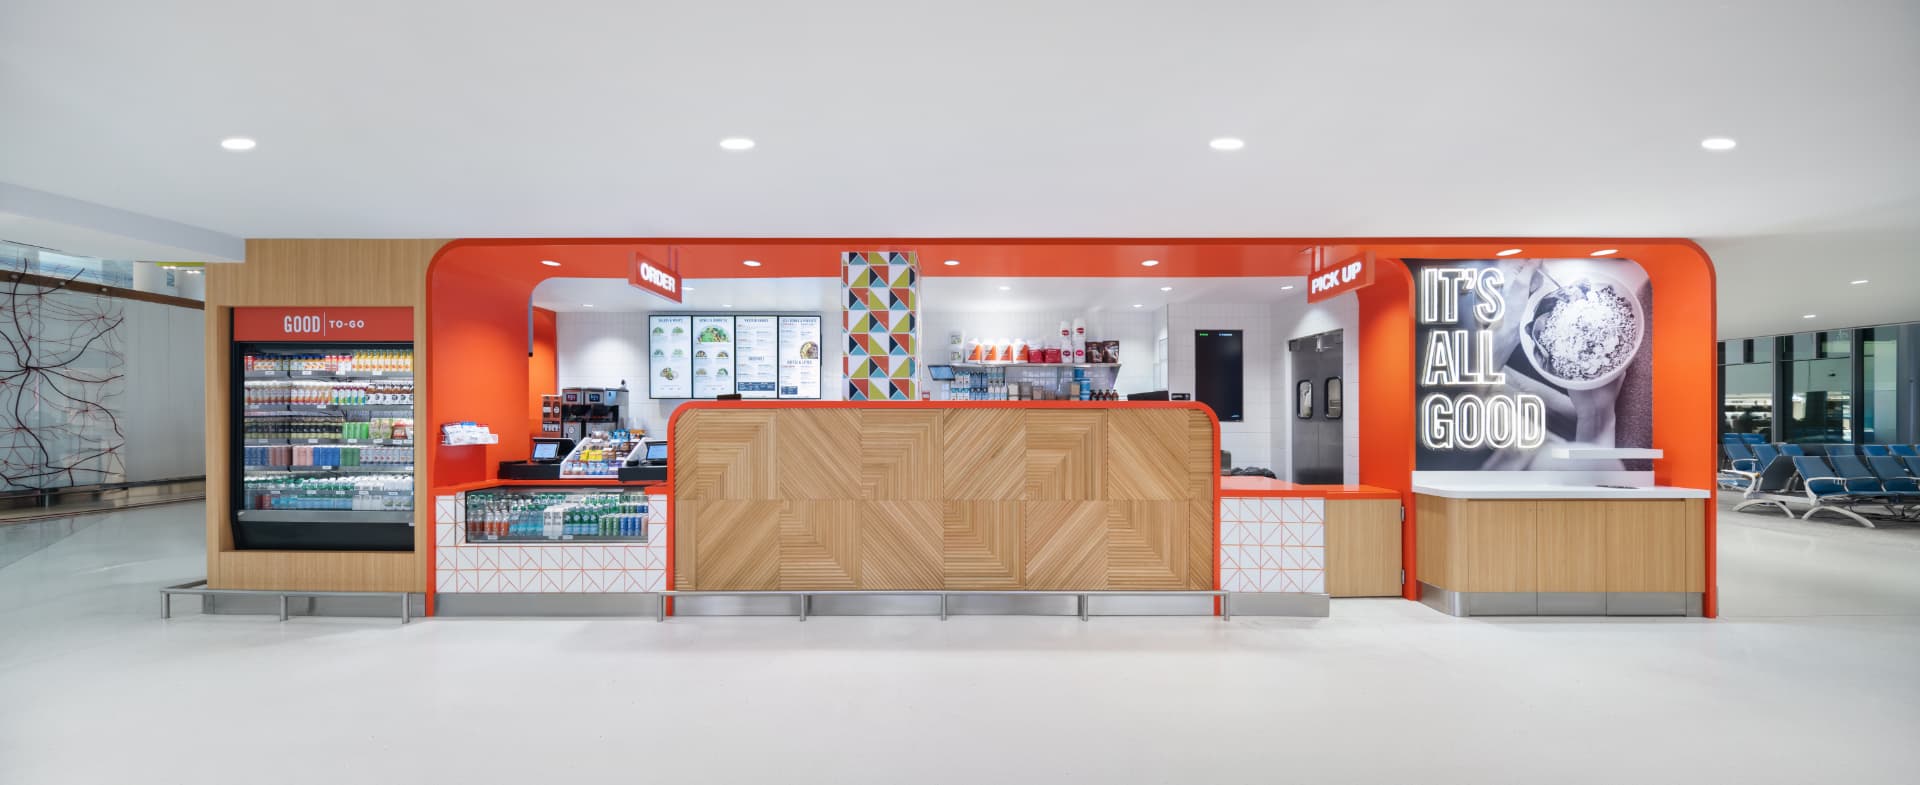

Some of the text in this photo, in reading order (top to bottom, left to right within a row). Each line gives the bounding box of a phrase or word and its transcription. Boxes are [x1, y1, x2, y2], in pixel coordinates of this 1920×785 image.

[640, 262, 676, 293] ORDER
[1311, 261, 1362, 294] PICK UP
[1422, 267, 1506, 323] IT'S
[284, 315, 365, 333] GOOD TO-GO
[1422, 329, 1506, 386] ALL
[1422, 393, 1547, 450] GOOD
